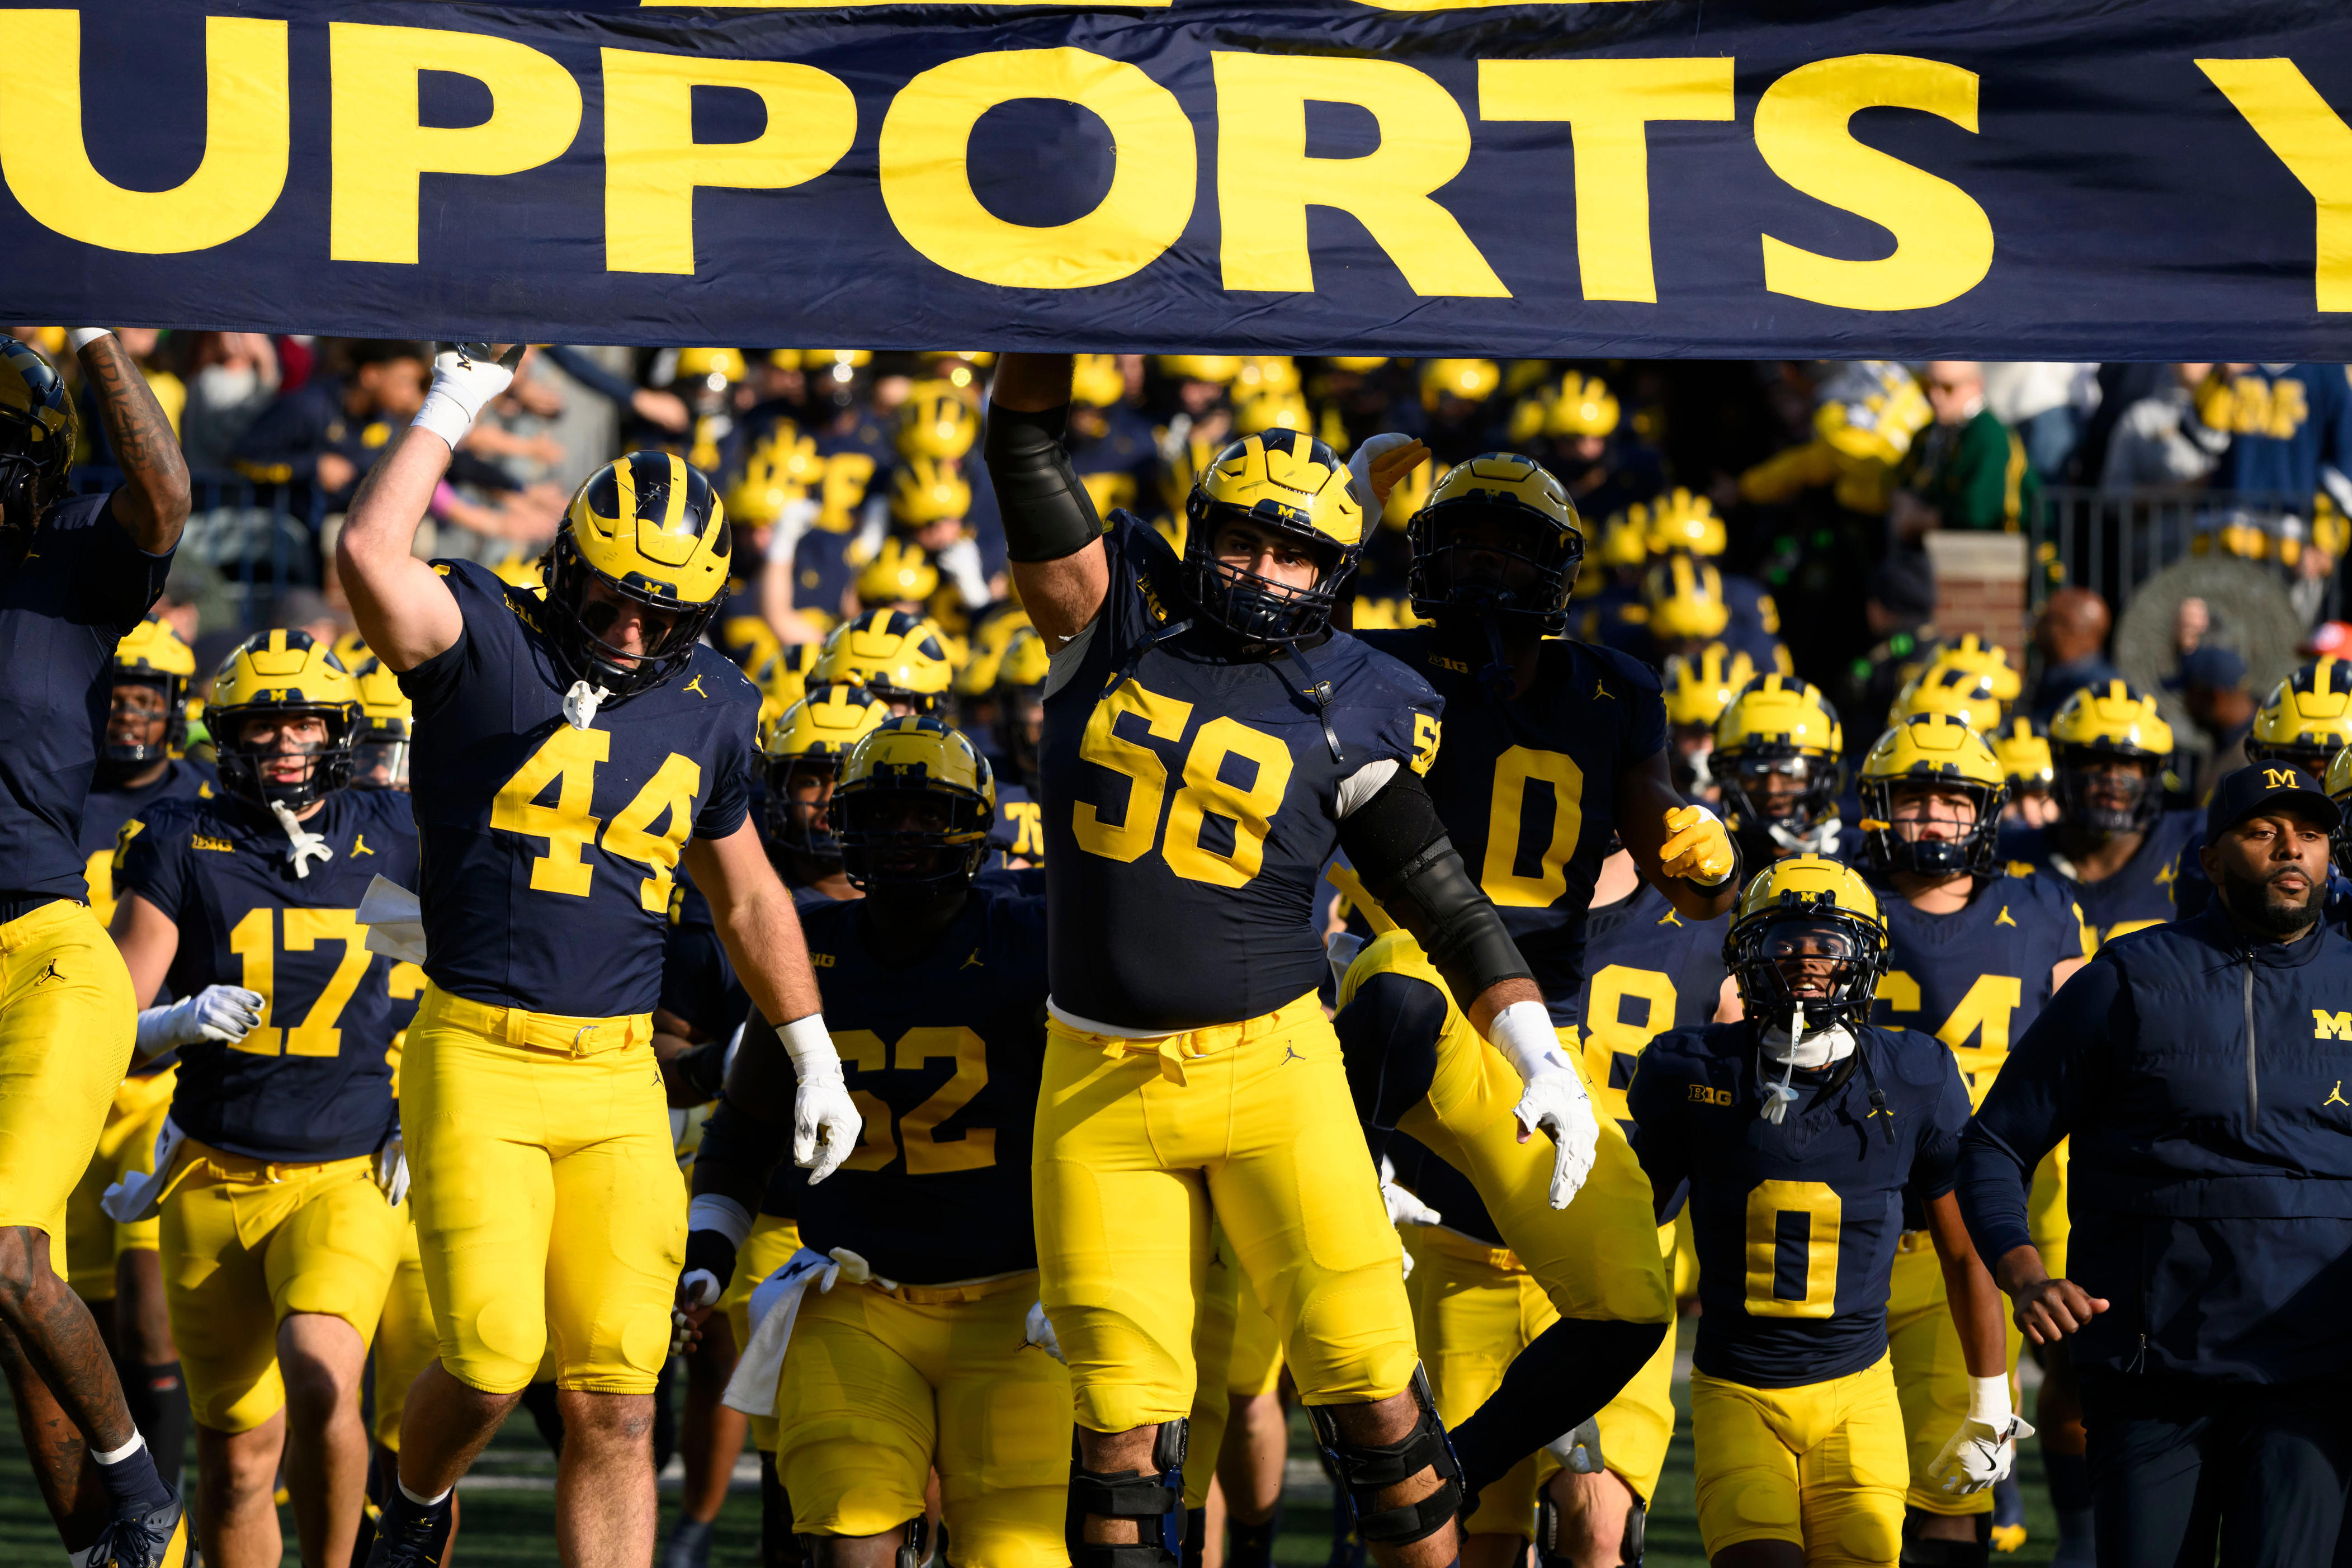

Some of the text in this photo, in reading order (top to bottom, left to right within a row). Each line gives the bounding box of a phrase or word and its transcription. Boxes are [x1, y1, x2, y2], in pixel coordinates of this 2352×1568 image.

[1278, 504, 1296, 518] M
[644, 581, 663, 594] M
[270, 689, 288, 701] M
[894, 765, 908, 775] M
[1072, 672, 1295, 889] 58
[2262, 768, 2301, 789] M
[490, 722, 701, 914] 44
[1480, 744, 1584, 908] 0
[1801, 891, 1816, 903] M
[227, 908, 373, 1057] 17
[2312, 1009, 2352, 1041] M
[1874, 970, 2022, 1117] 4
[1744, 1179, 1841, 1319] 0
